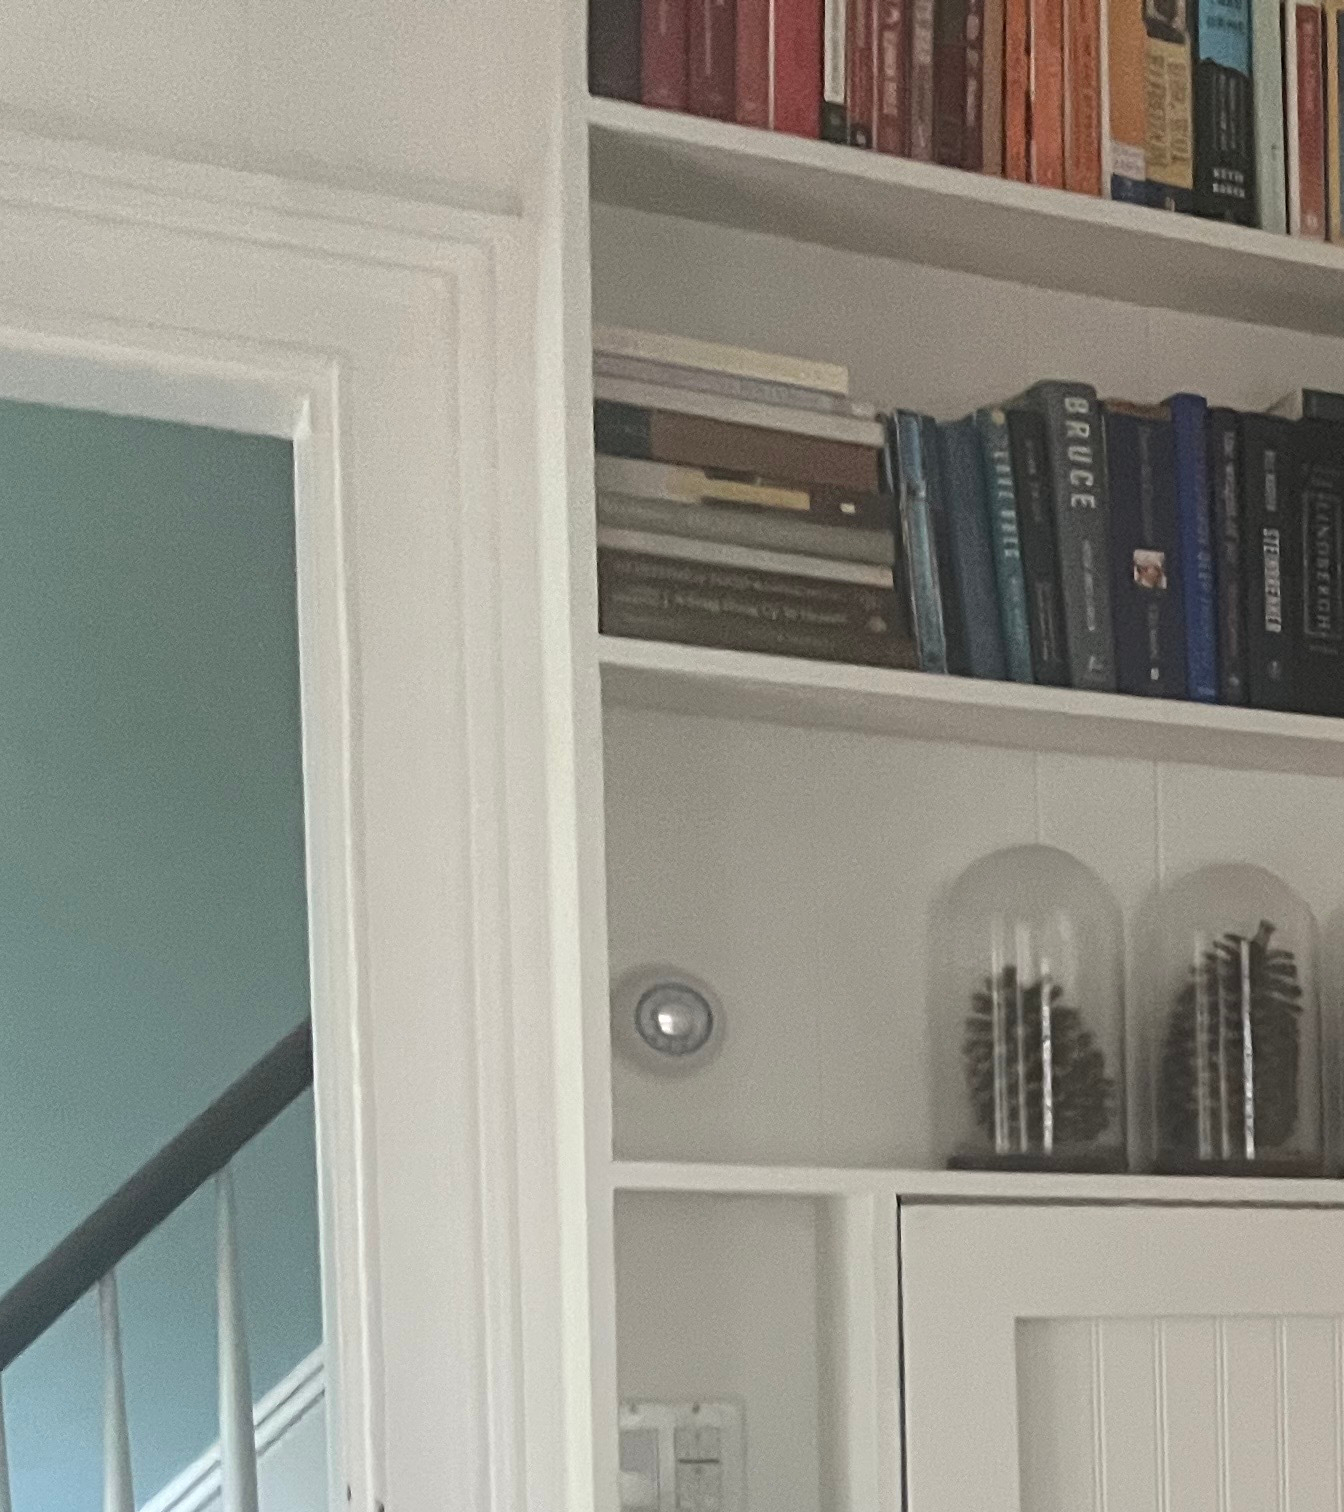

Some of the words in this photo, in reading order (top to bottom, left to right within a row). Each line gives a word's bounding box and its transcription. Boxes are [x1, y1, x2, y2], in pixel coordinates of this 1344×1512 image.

[1064, 396, 1096, 509] BRUCE
[1263, 528, 1282, 633] STEINBRENNER
[1315, 500, 1331, 630] LINDBERGH
